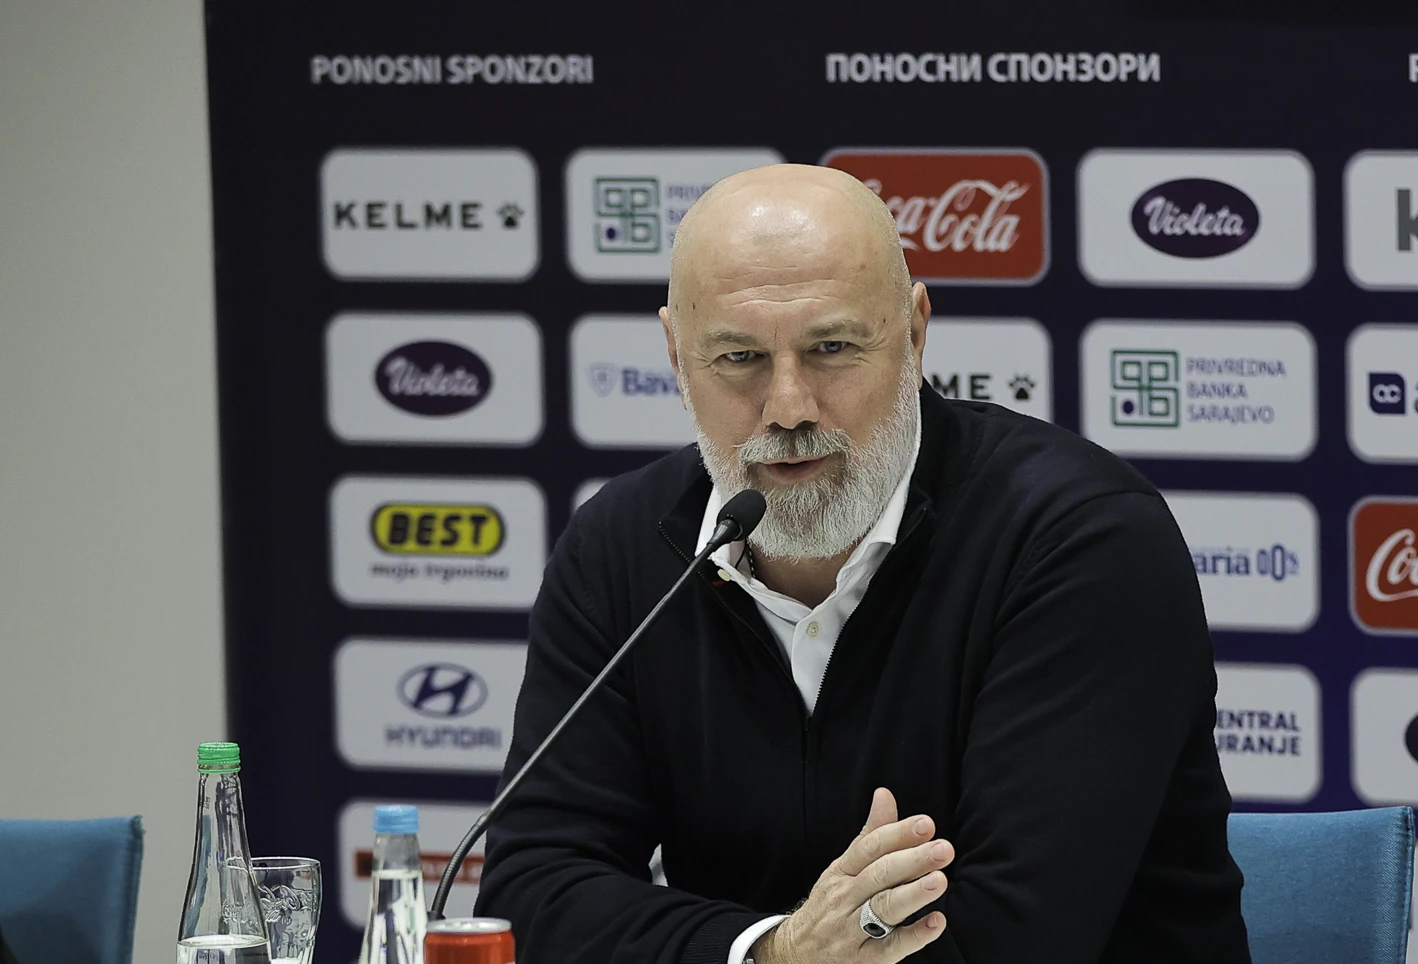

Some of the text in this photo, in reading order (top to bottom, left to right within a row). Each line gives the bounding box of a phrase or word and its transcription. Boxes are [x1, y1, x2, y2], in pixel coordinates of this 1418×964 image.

[312, 54, 594, 84] PONOSNI SPONZORI
[826, 52, 1161, 83] ПОНОСНИ СПОНЗОРИ
[334, 202, 483, 229] KELME
[1144, 196, 1249, 237] Violeta
[384, 358, 482, 398] Violeta
[1187, 358, 1286, 378] PRIVREDNA
[1187, 382, 1247, 400] BANKA
[1187, 405, 1275, 425] SARAJEVO
[387, 512, 490, 547] BEST
[1194, 547, 1251, 575] aria
[1216, 709, 1301, 732] ENTRAL
